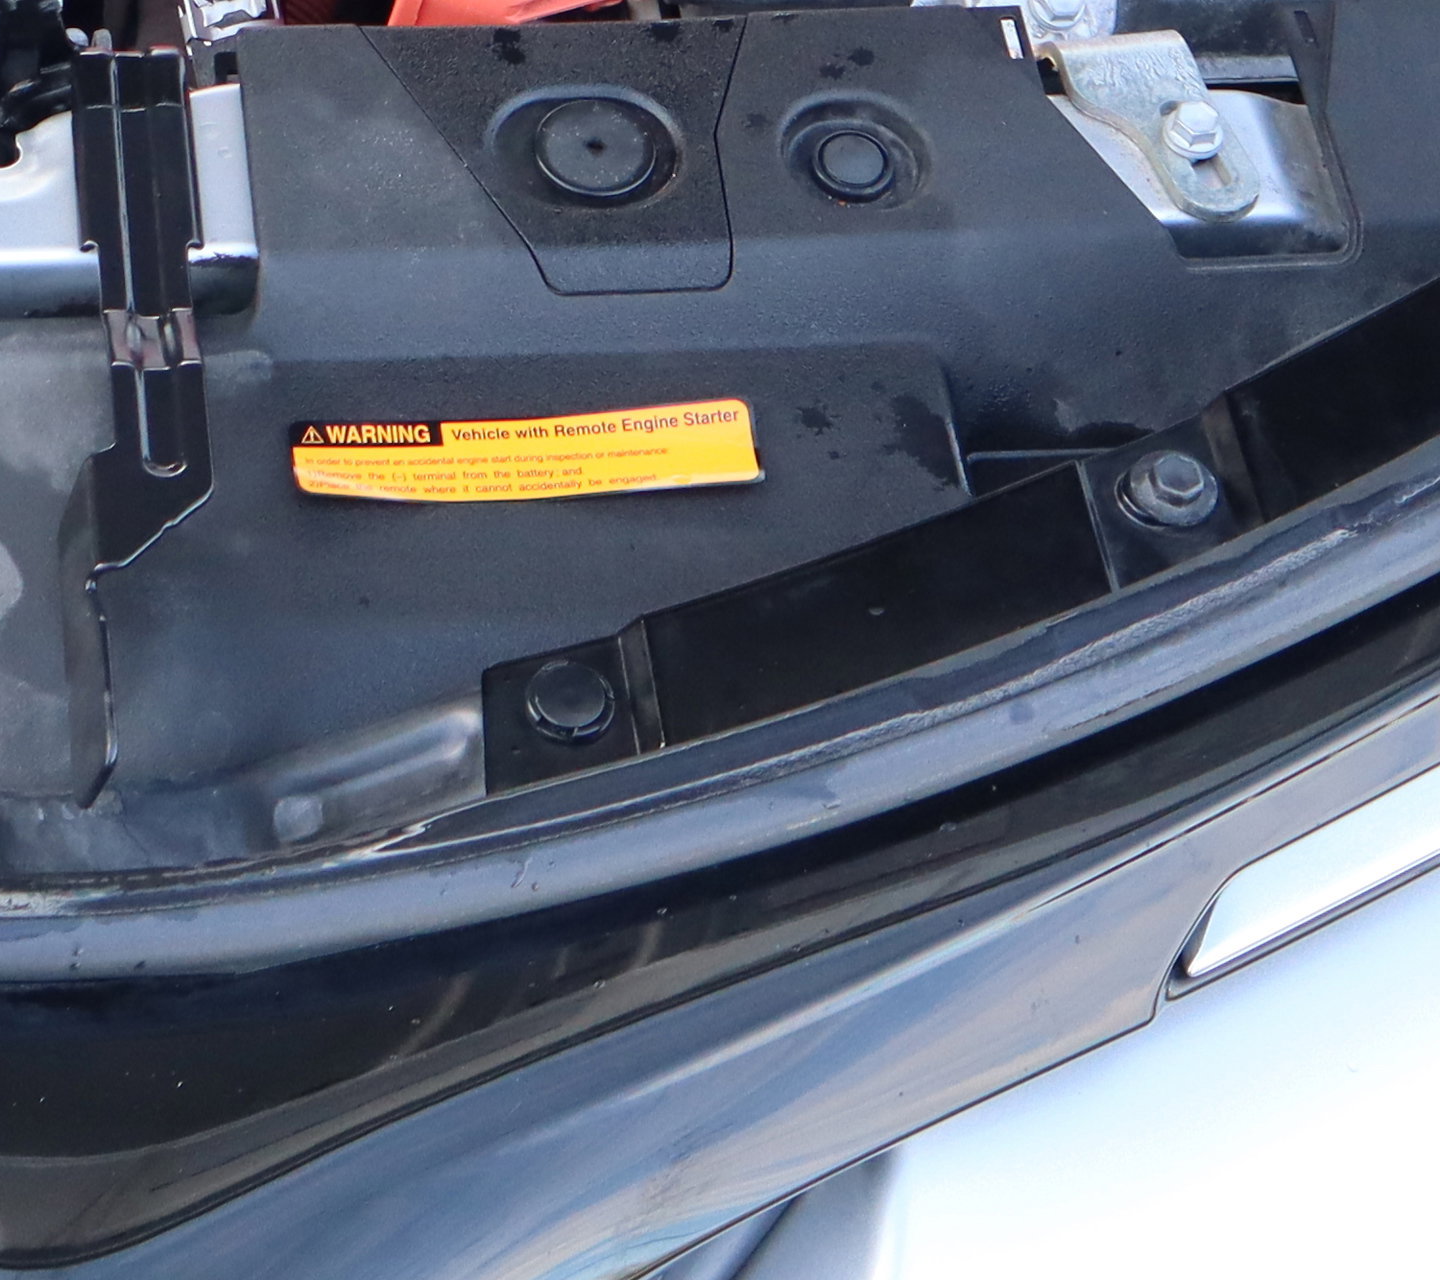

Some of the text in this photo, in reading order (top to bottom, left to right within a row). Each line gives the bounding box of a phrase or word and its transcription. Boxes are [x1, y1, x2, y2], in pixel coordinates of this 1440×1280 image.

[325, 409, 740, 444] WARNING Vehicle with Remote Engine Starter
[355, 458, 390, 467] prevent
[408, 457, 455, 465] accidental
[457, 456, 488, 465] engine
[491, 455, 511, 463] start
[514, 454, 543, 464] during
[546, 452, 593, 462] inspection
[368, 472, 385, 480] the
[413, 471, 456, 480] terminal
[463, 471, 487, 479] from
[494, 470, 511, 478] the
[562, 467, 582, 476] and
[379, 485, 417, 493] remote
[423, 484, 456, 493] where
[475, 483, 512, 493] cannot
[519, 480, 582, 491] accidentally
[588, 478, 602, 486] be
